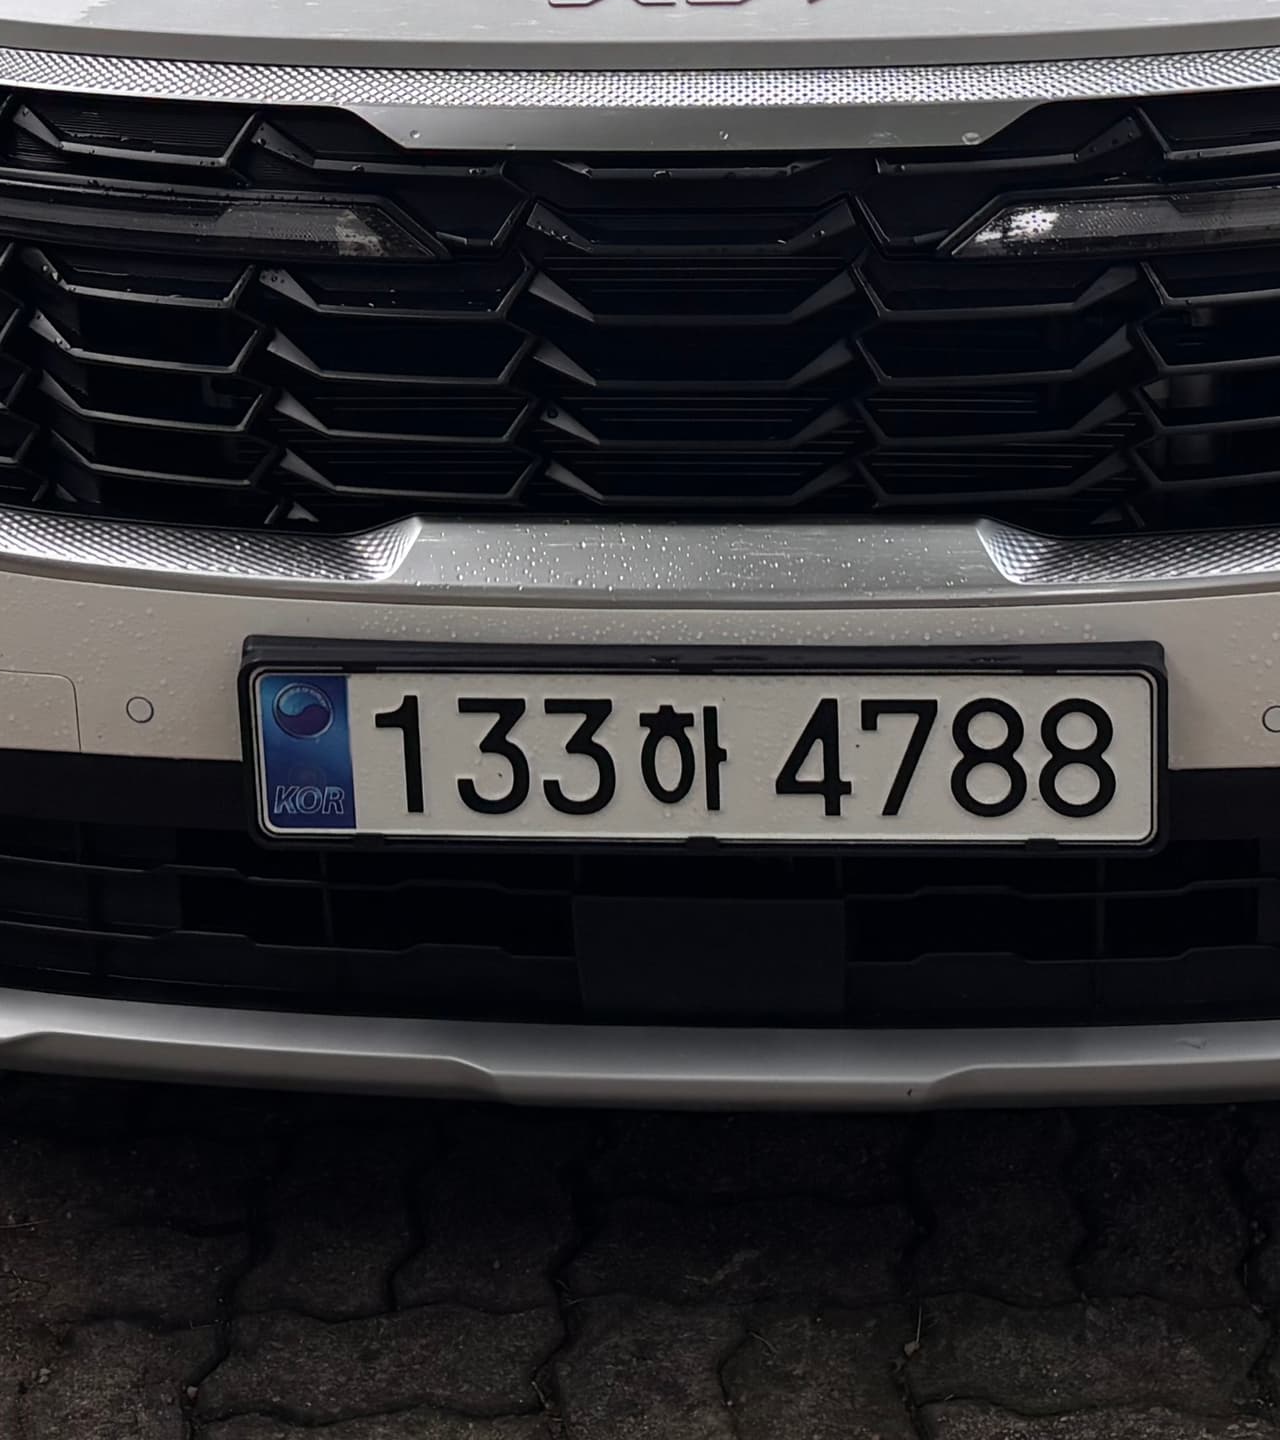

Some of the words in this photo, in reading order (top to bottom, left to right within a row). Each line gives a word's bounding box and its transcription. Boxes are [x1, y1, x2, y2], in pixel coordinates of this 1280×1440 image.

[374, 693, 728, 817] 133하
[775, 695, 1118, 820] 4788
[273, 785, 345, 815] KOR
